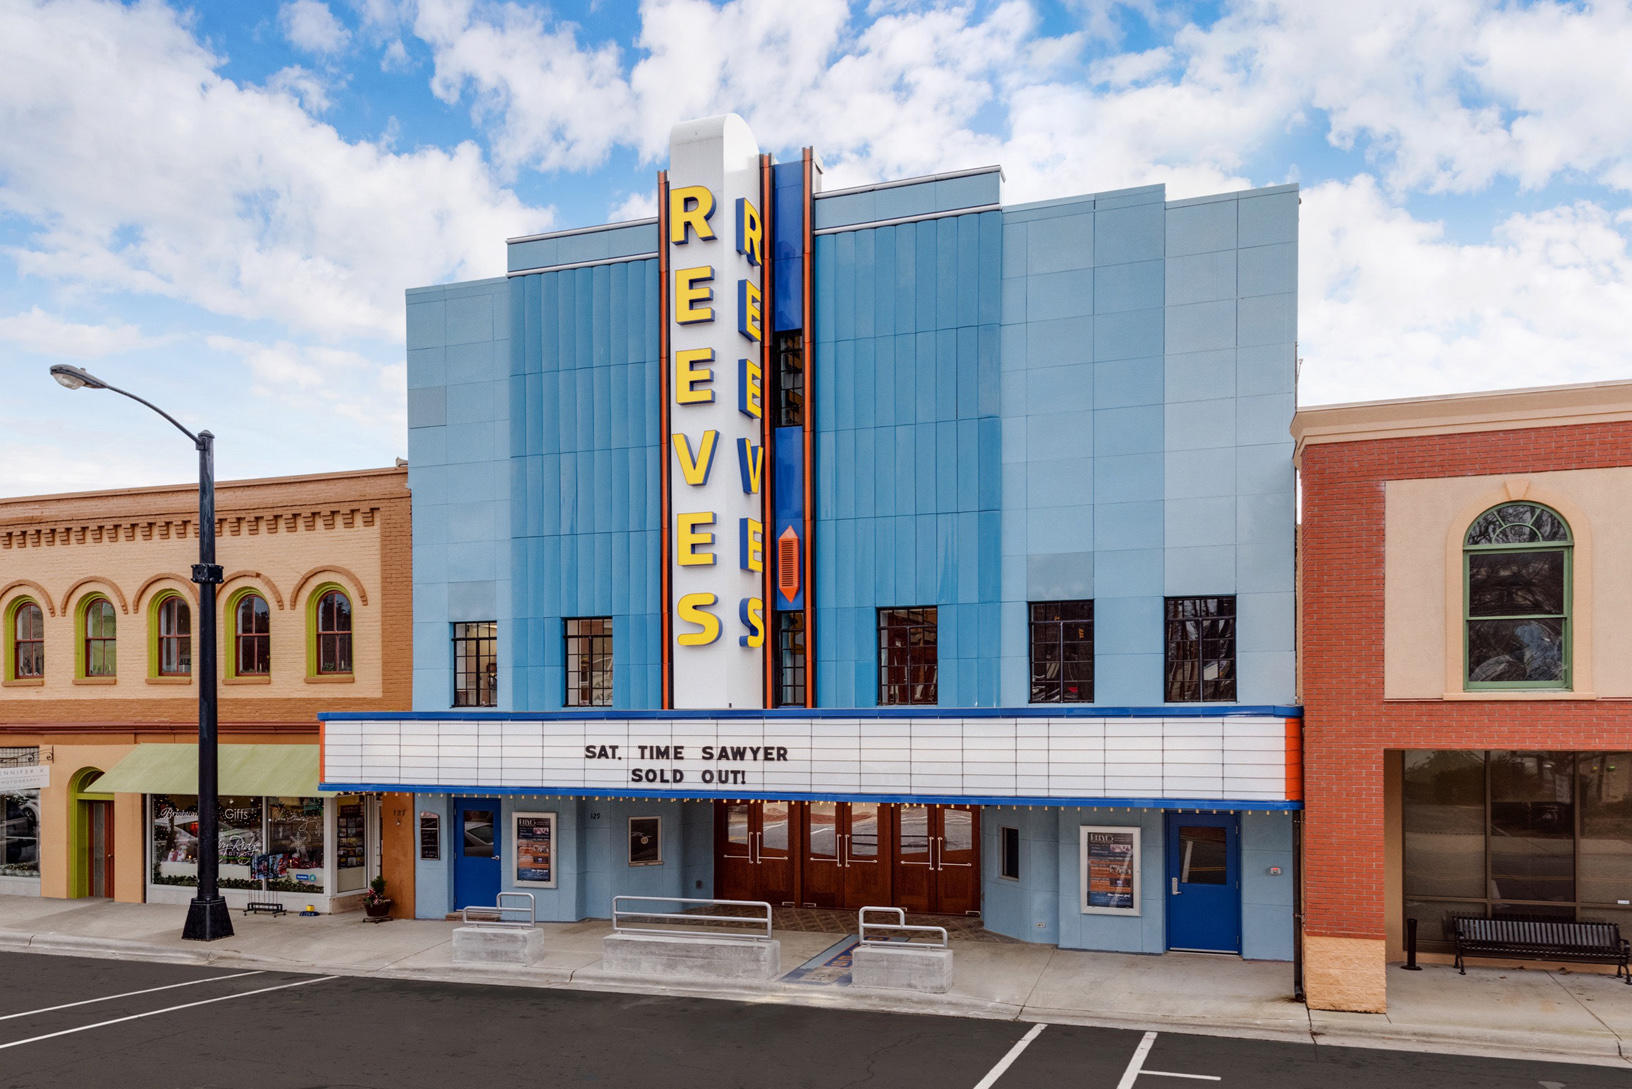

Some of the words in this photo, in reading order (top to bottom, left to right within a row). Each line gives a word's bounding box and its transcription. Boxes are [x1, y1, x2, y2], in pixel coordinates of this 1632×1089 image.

[670, 185, 723, 647] REEVES
[736, 197, 764, 648] REEVES
[584, 745, 622, 761] SAT.
[637, 745, 684, 760] TIME
[701, 746, 788, 761] SAWYER
[631, 768, 684, 783] SOLD
[701, 769, 746, 784] OUT!
